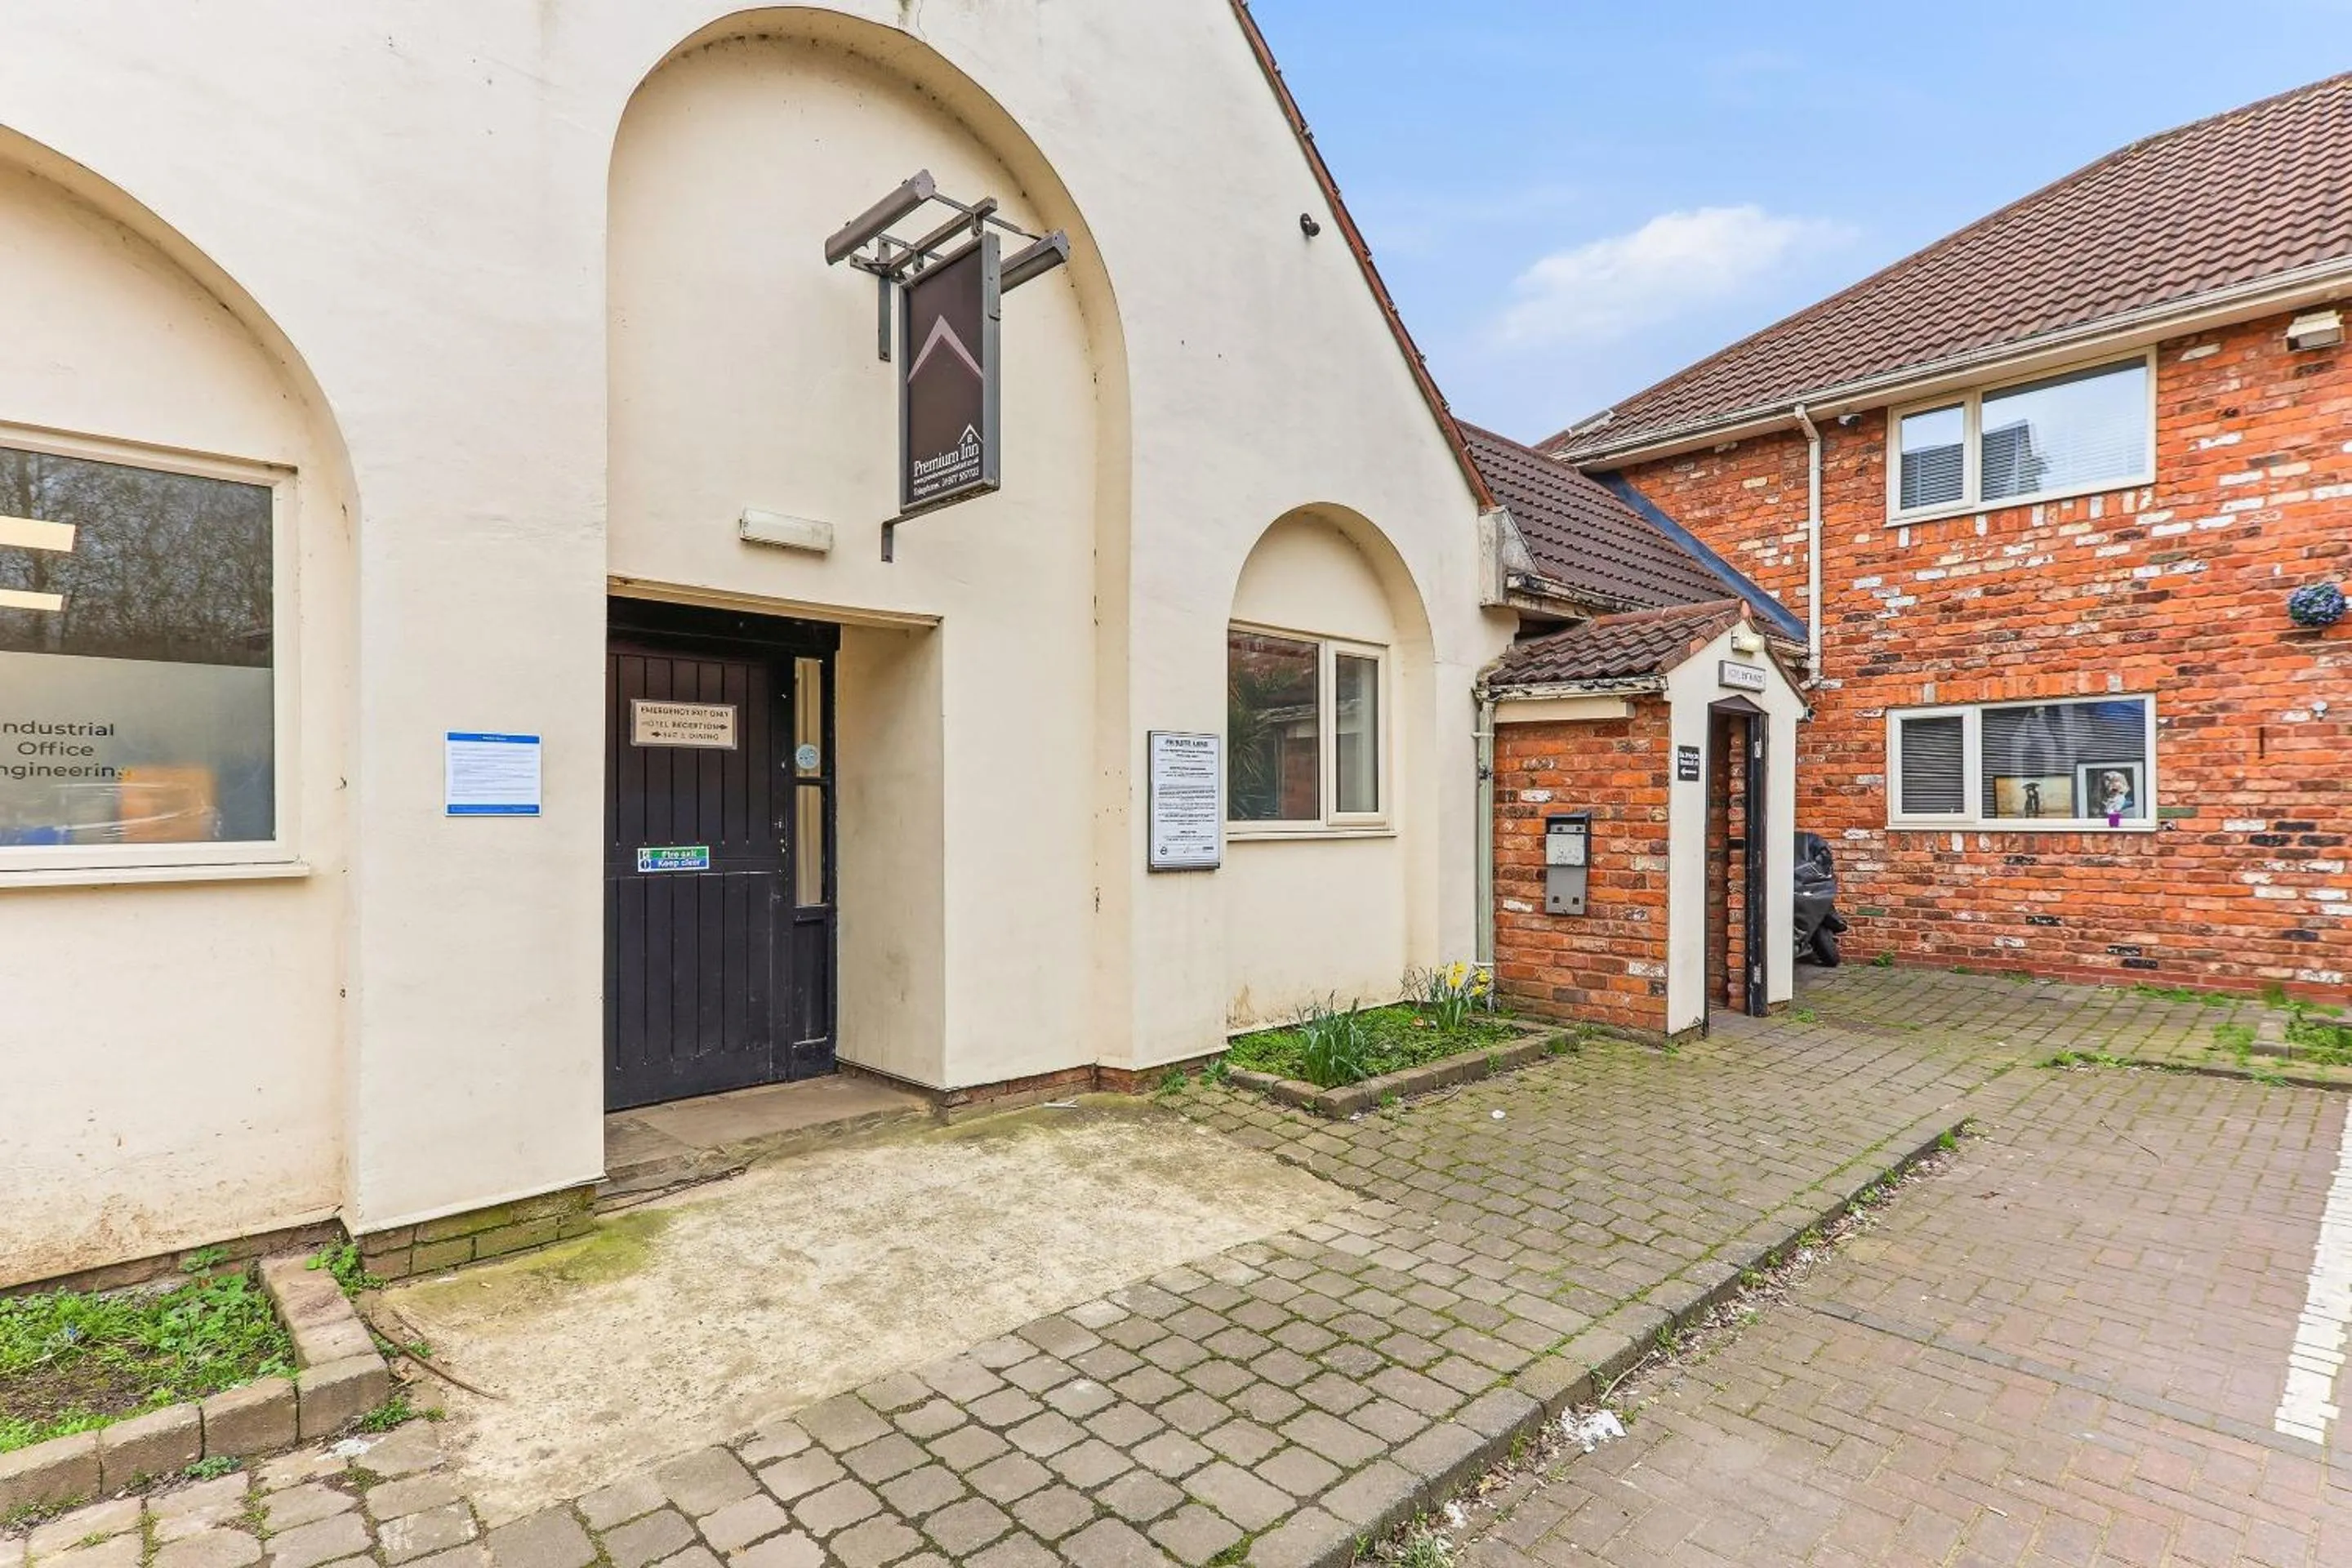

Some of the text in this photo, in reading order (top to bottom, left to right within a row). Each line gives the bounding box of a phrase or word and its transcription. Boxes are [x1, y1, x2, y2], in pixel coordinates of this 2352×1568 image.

[913, 452, 959, 477] Premium
[960, 443, 979, 460] Inn
[641, 706, 728, 718] EMERGENCY EXIT ONLY
[641, 719, 719, 729] HOTEL RECEPTION
[688, 732, 719, 740] DINING
[17, 741, 95, 756] Office
[662, 849, 697, 858] Fire exit
[658, 858, 700, 868] Keep clear
